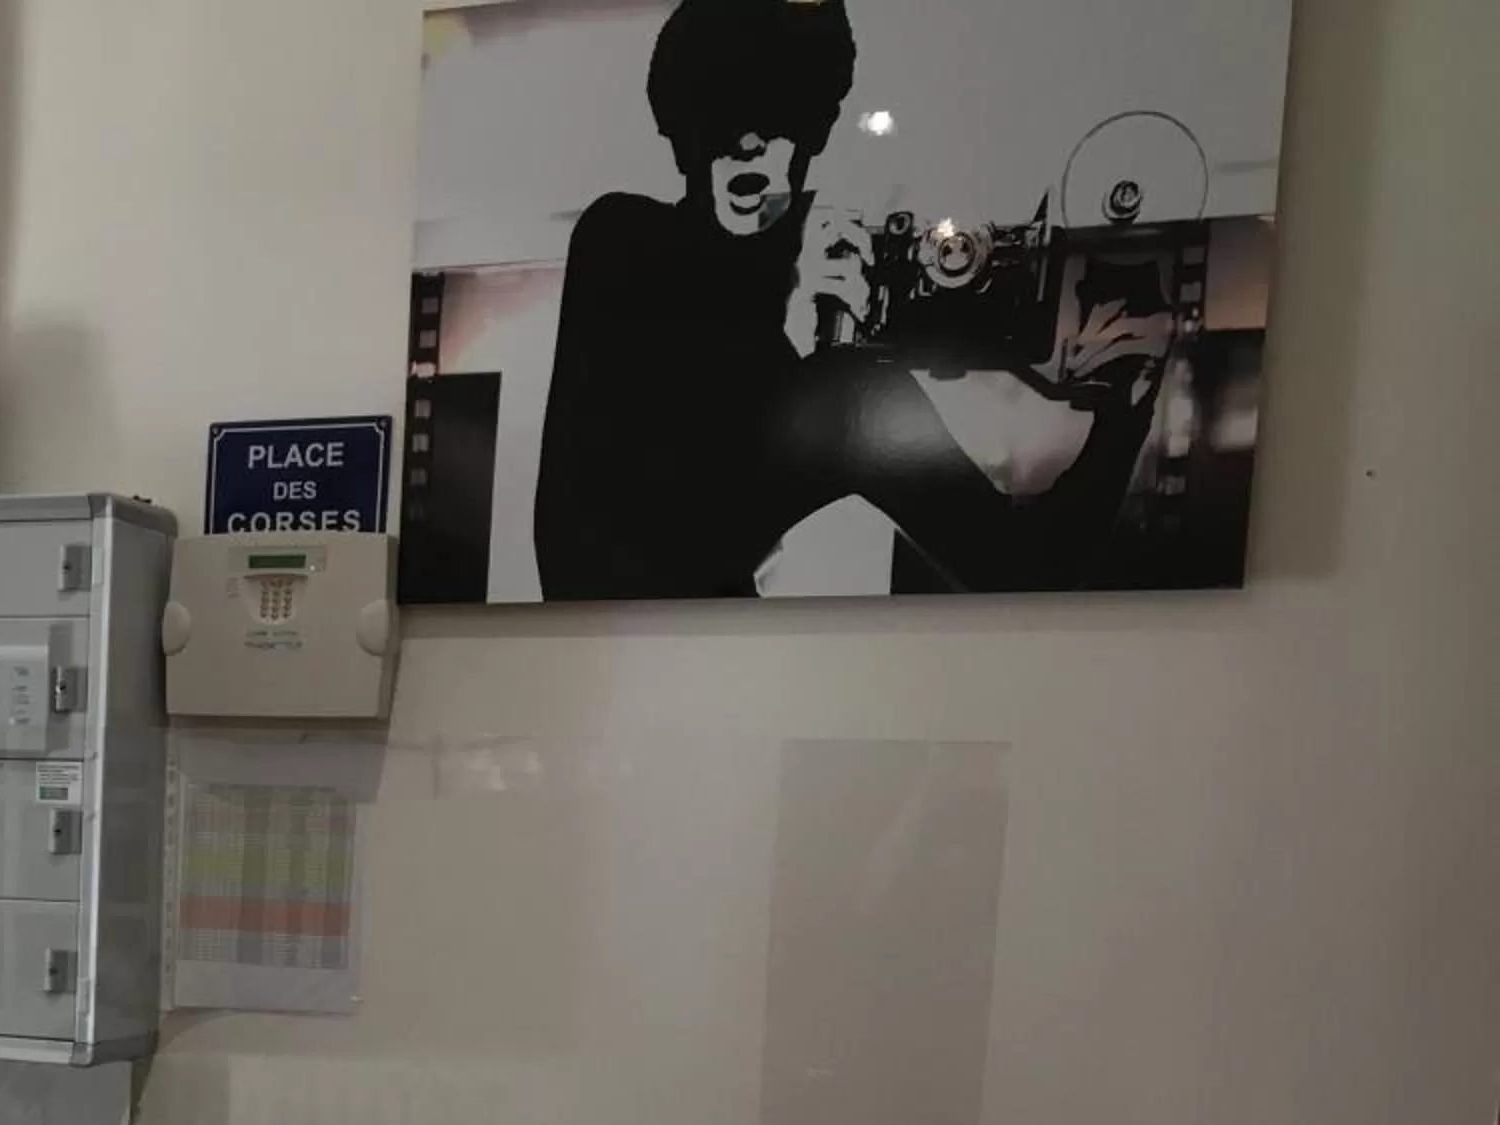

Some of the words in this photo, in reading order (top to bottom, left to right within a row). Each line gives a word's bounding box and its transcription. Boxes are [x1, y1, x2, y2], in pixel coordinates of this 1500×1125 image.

[248, 442, 345, 469] PLACE
[272, 480, 318, 501] DES
[227, 509, 361, 533] CORSES
